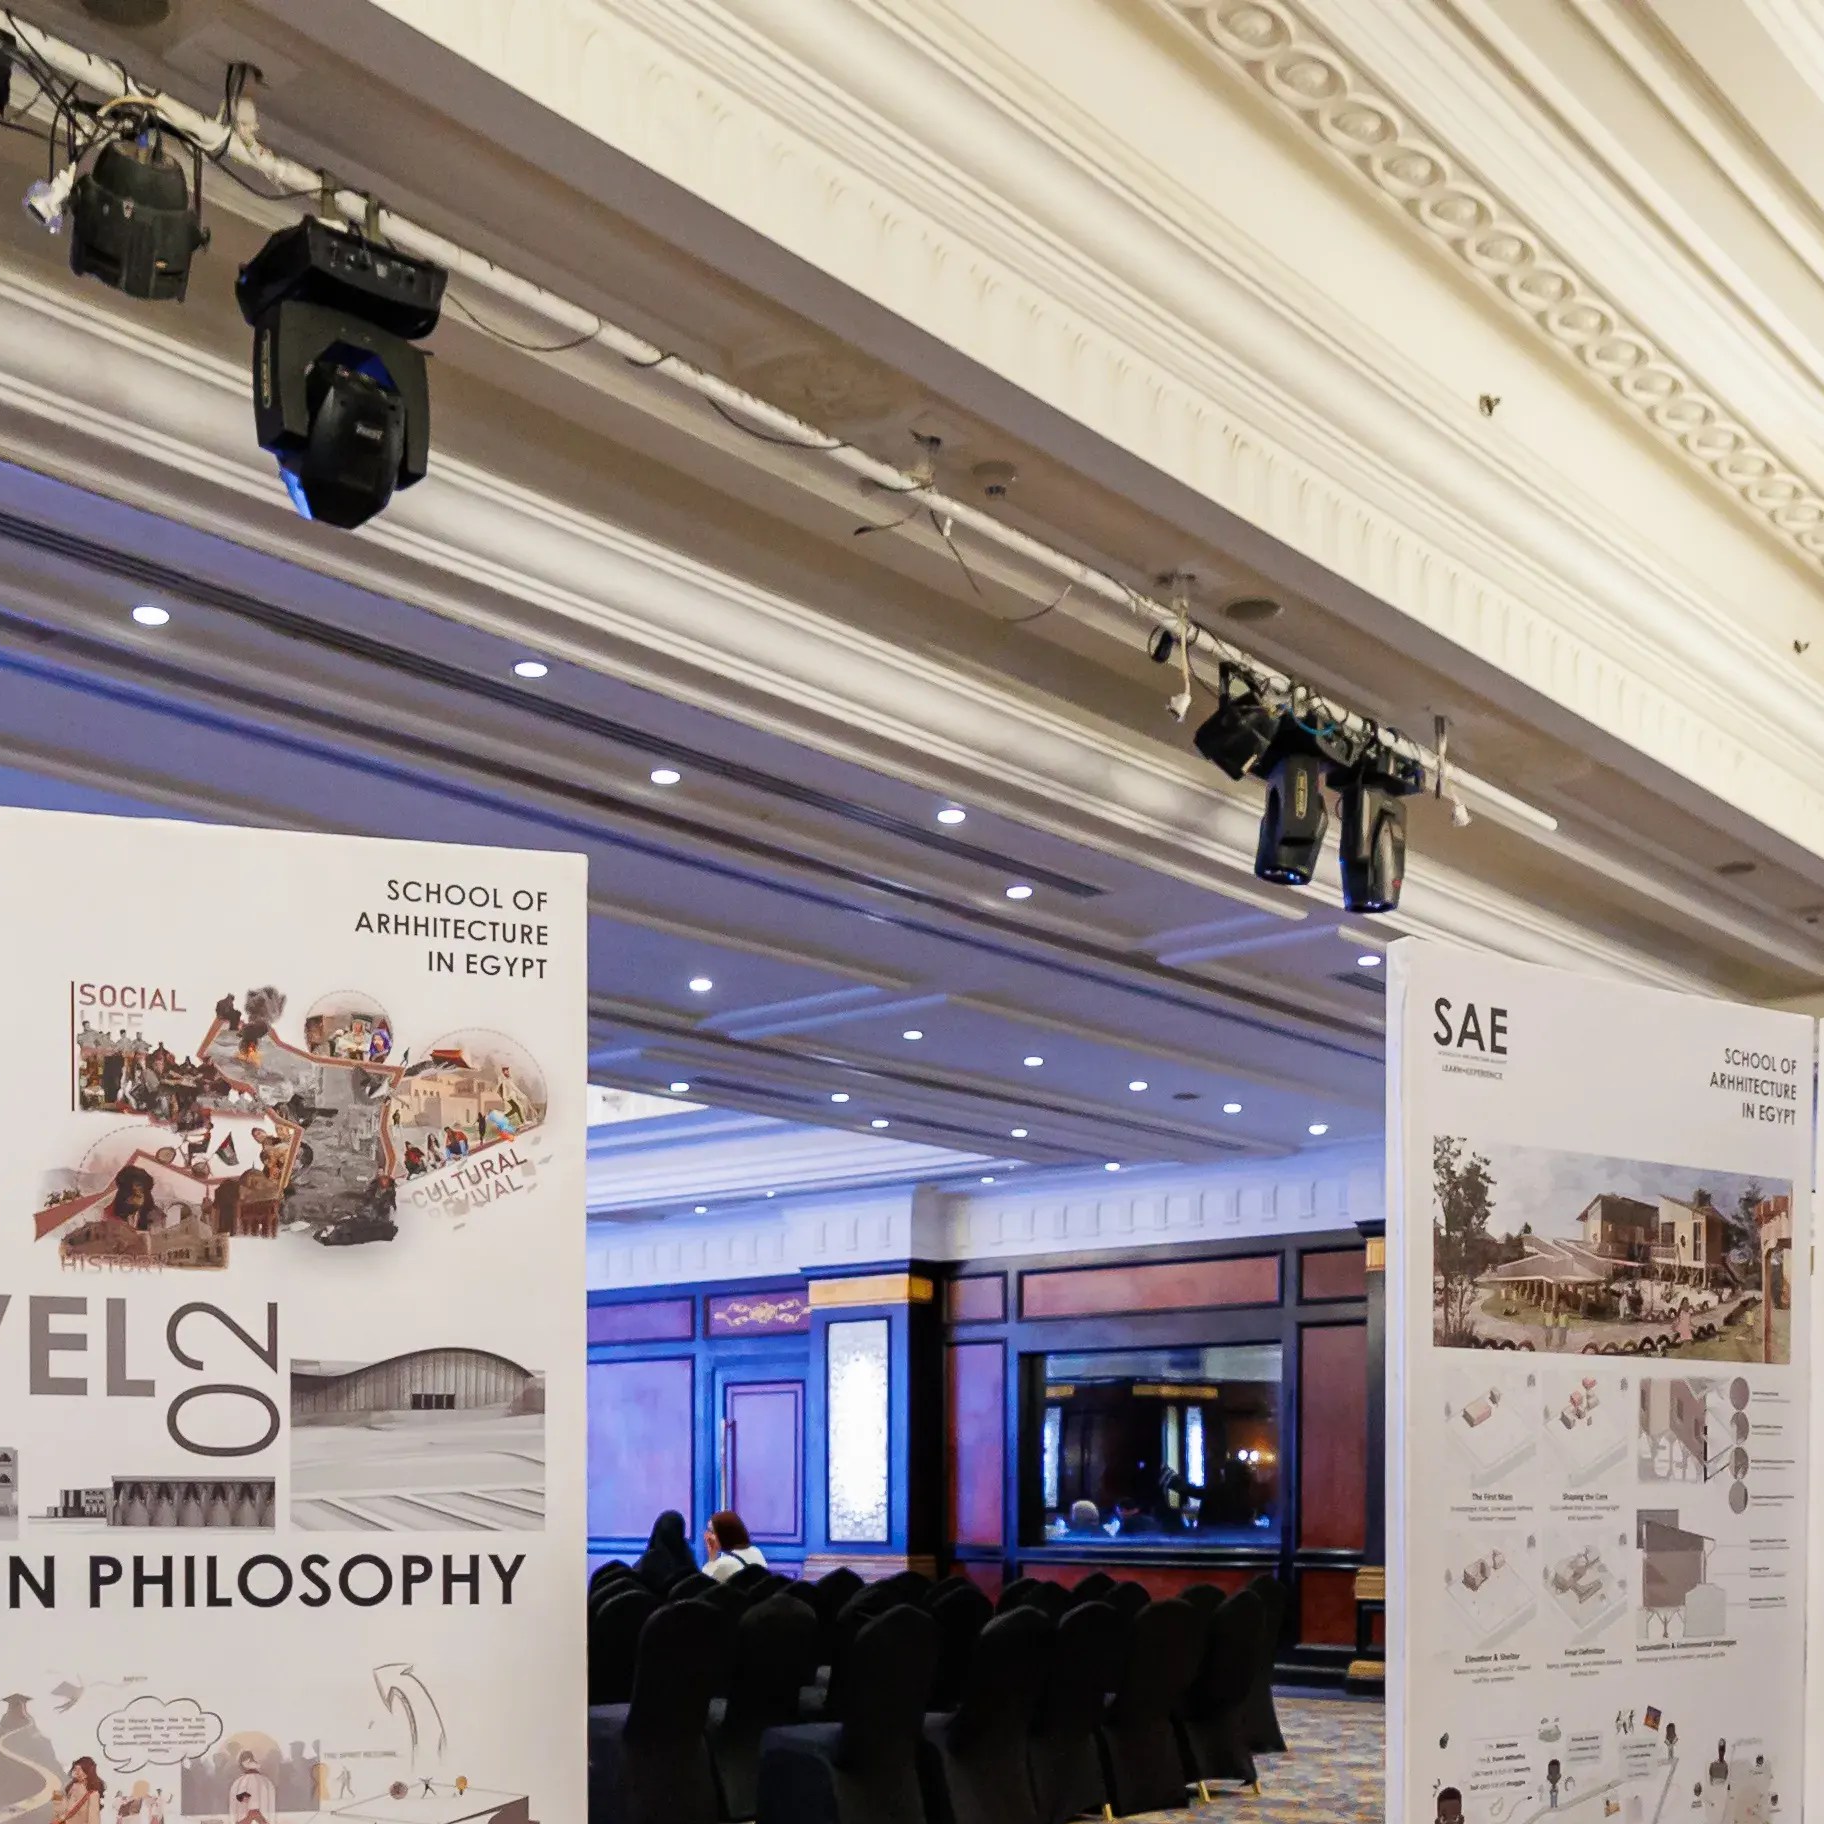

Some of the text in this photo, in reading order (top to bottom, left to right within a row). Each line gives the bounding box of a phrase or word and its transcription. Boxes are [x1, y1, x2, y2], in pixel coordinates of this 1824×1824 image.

[387, 879, 548, 911] SCHOOL OF
[355, 911, 548, 946] ARHHITECTURE
[428, 951, 547, 979] IN EGYPT
[79, 983, 187, 1012] SOCIAL
[1433, 997, 1507, 1055] SAE
[1724, 1047, 1797, 1075] SCHOOL OF
[1710, 1071, 1797, 1100] ARHHITECTURE
[1742, 1102, 1795, 1125] IN EGYPT
[411, 1148, 527, 1209] CULTURAL
[428, 1174, 523, 1218] VIVAL
[165, 1300, 281, 1459] 02
[89, 1552, 527, 1611] PHILOSOPHY
